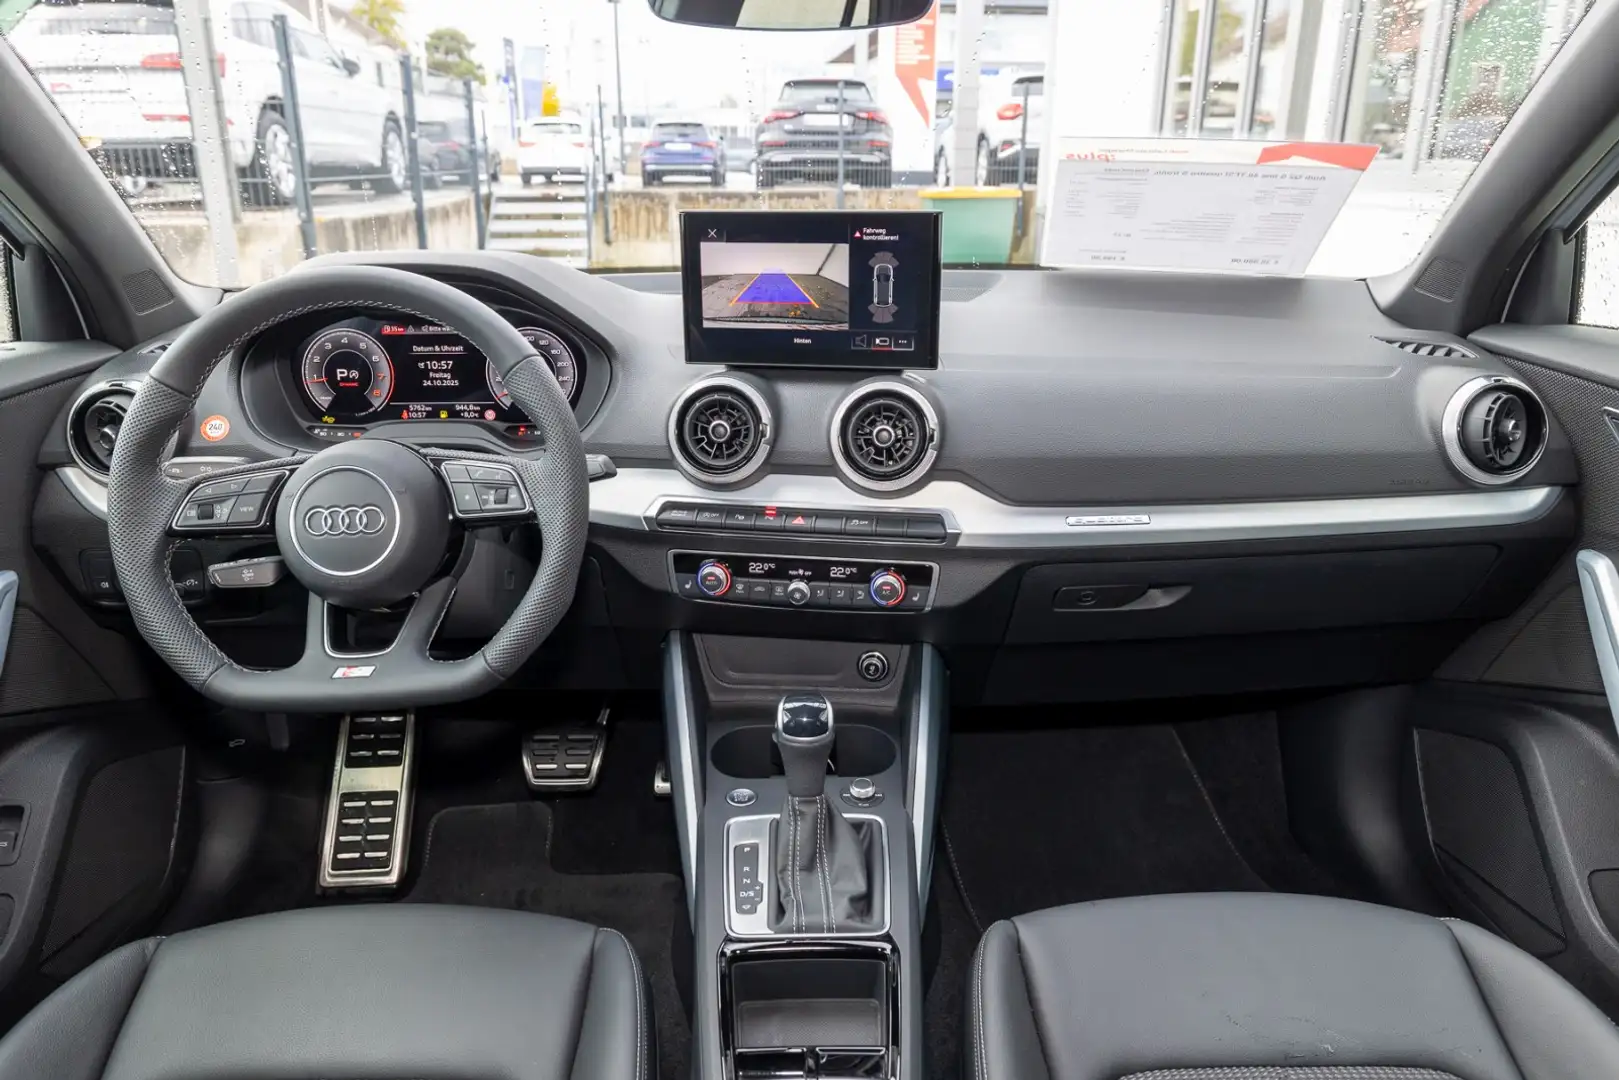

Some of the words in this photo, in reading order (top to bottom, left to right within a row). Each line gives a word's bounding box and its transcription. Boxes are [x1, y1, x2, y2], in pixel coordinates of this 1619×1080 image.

[863, 227, 887, 235] Fahrweg
[324, 342, 333, 350] 3
[360, 342, 367, 350] 5
[313, 355, 321, 363] 2
[426, 360, 453, 370] 10:57
[336, 368, 348, 381] P
[429, 371, 451, 379] Freitag
[408, 411, 427, 419] 10:57
[208, 423, 223, 431] 240
[739, 890, 755, 898] D/S
